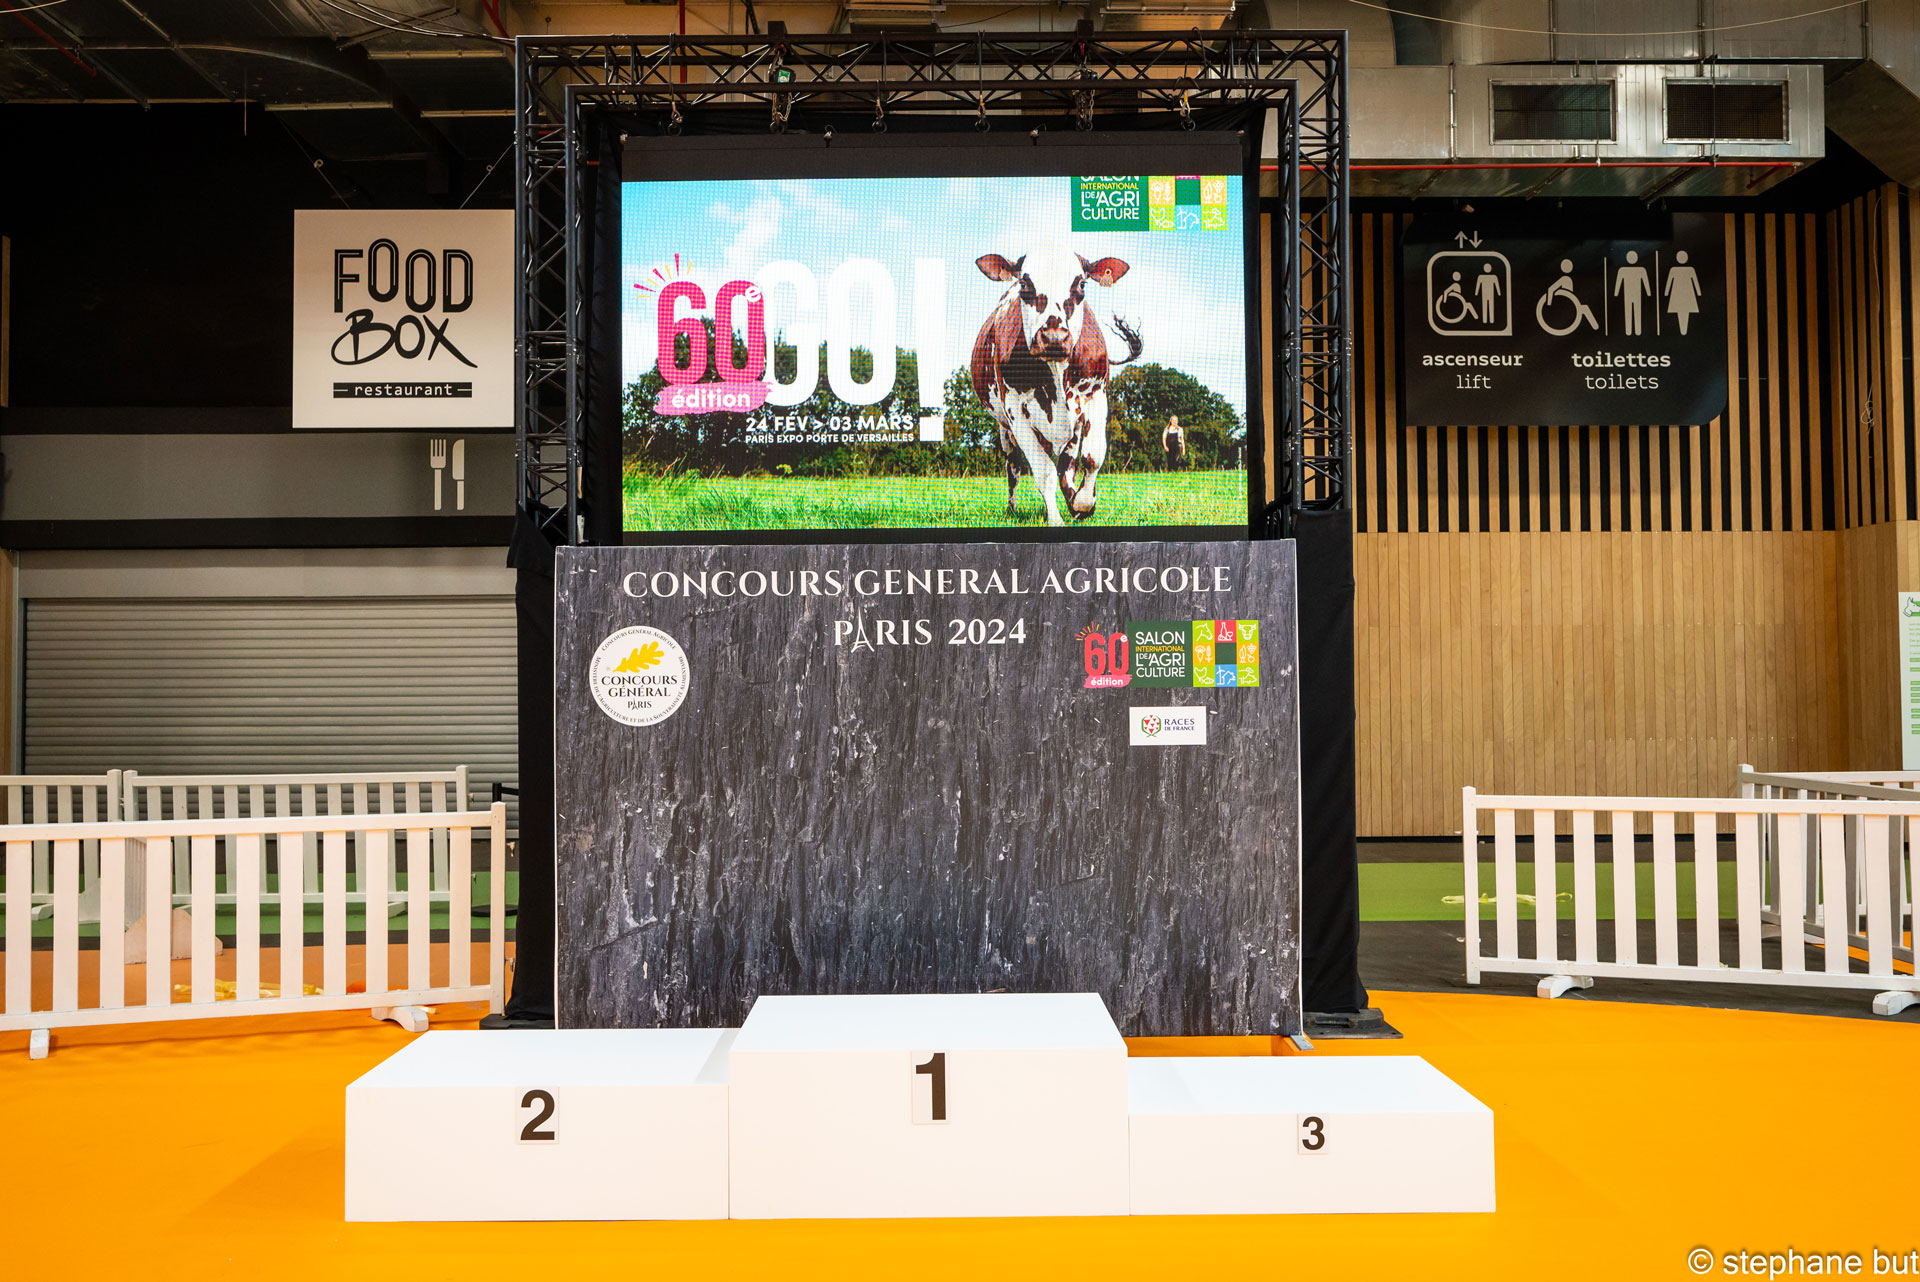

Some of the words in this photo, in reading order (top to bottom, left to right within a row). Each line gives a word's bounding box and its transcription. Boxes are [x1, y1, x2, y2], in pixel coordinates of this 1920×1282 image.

[1080, 182, 1140, 190] INTERNATIONAL
[1081, 208, 1140, 220] CULTURE
[334, 238, 473, 313] FOOD
[1422, 354, 1523, 366] ascenseur
[1571, 351, 1672, 367] toilettes
[1456, 374, 1491, 389] lift
[1585, 374, 1659, 390] toilets
[354, 383, 453, 396] restaurant
[671, 388, 751, 408] édition
[745, 416, 768, 432] 24
[774, 414, 808, 431] FÉV
[829, 416, 852, 431] 03
[857, 415, 914, 430] MARS
[745, 434, 774, 444] PARIS
[777, 434, 804, 443] EXPO
[806, 434, 839, 443] PORTE
[841, 434, 855, 442] DE
[856, 433, 914, 442] VERSAILLES
[623, 570, 842, 598] CONCOURS
[854, 568, 1029, 596] GENERAL
[1040, 566, 1232, 594] AGRICOLE
[834, 606, 932, 653] PARIS
[948, 617, 1026, 645] 2024
[1136, 631, 1185, 645] SALON
[1136, 667, 1185, 677] CULTURE
[601, 675, 678, 686] CONCOURS
[1090, 676, 1124, 686] édition
[608, 684, 671, 697] GÉNÉRAL
[627, 698, 652, 710] PARIS
[915, 1053, 946, 1120] 1
[520, 1089, 555, 1141] 2
[1302, 1116, 1325, 1151] 3
